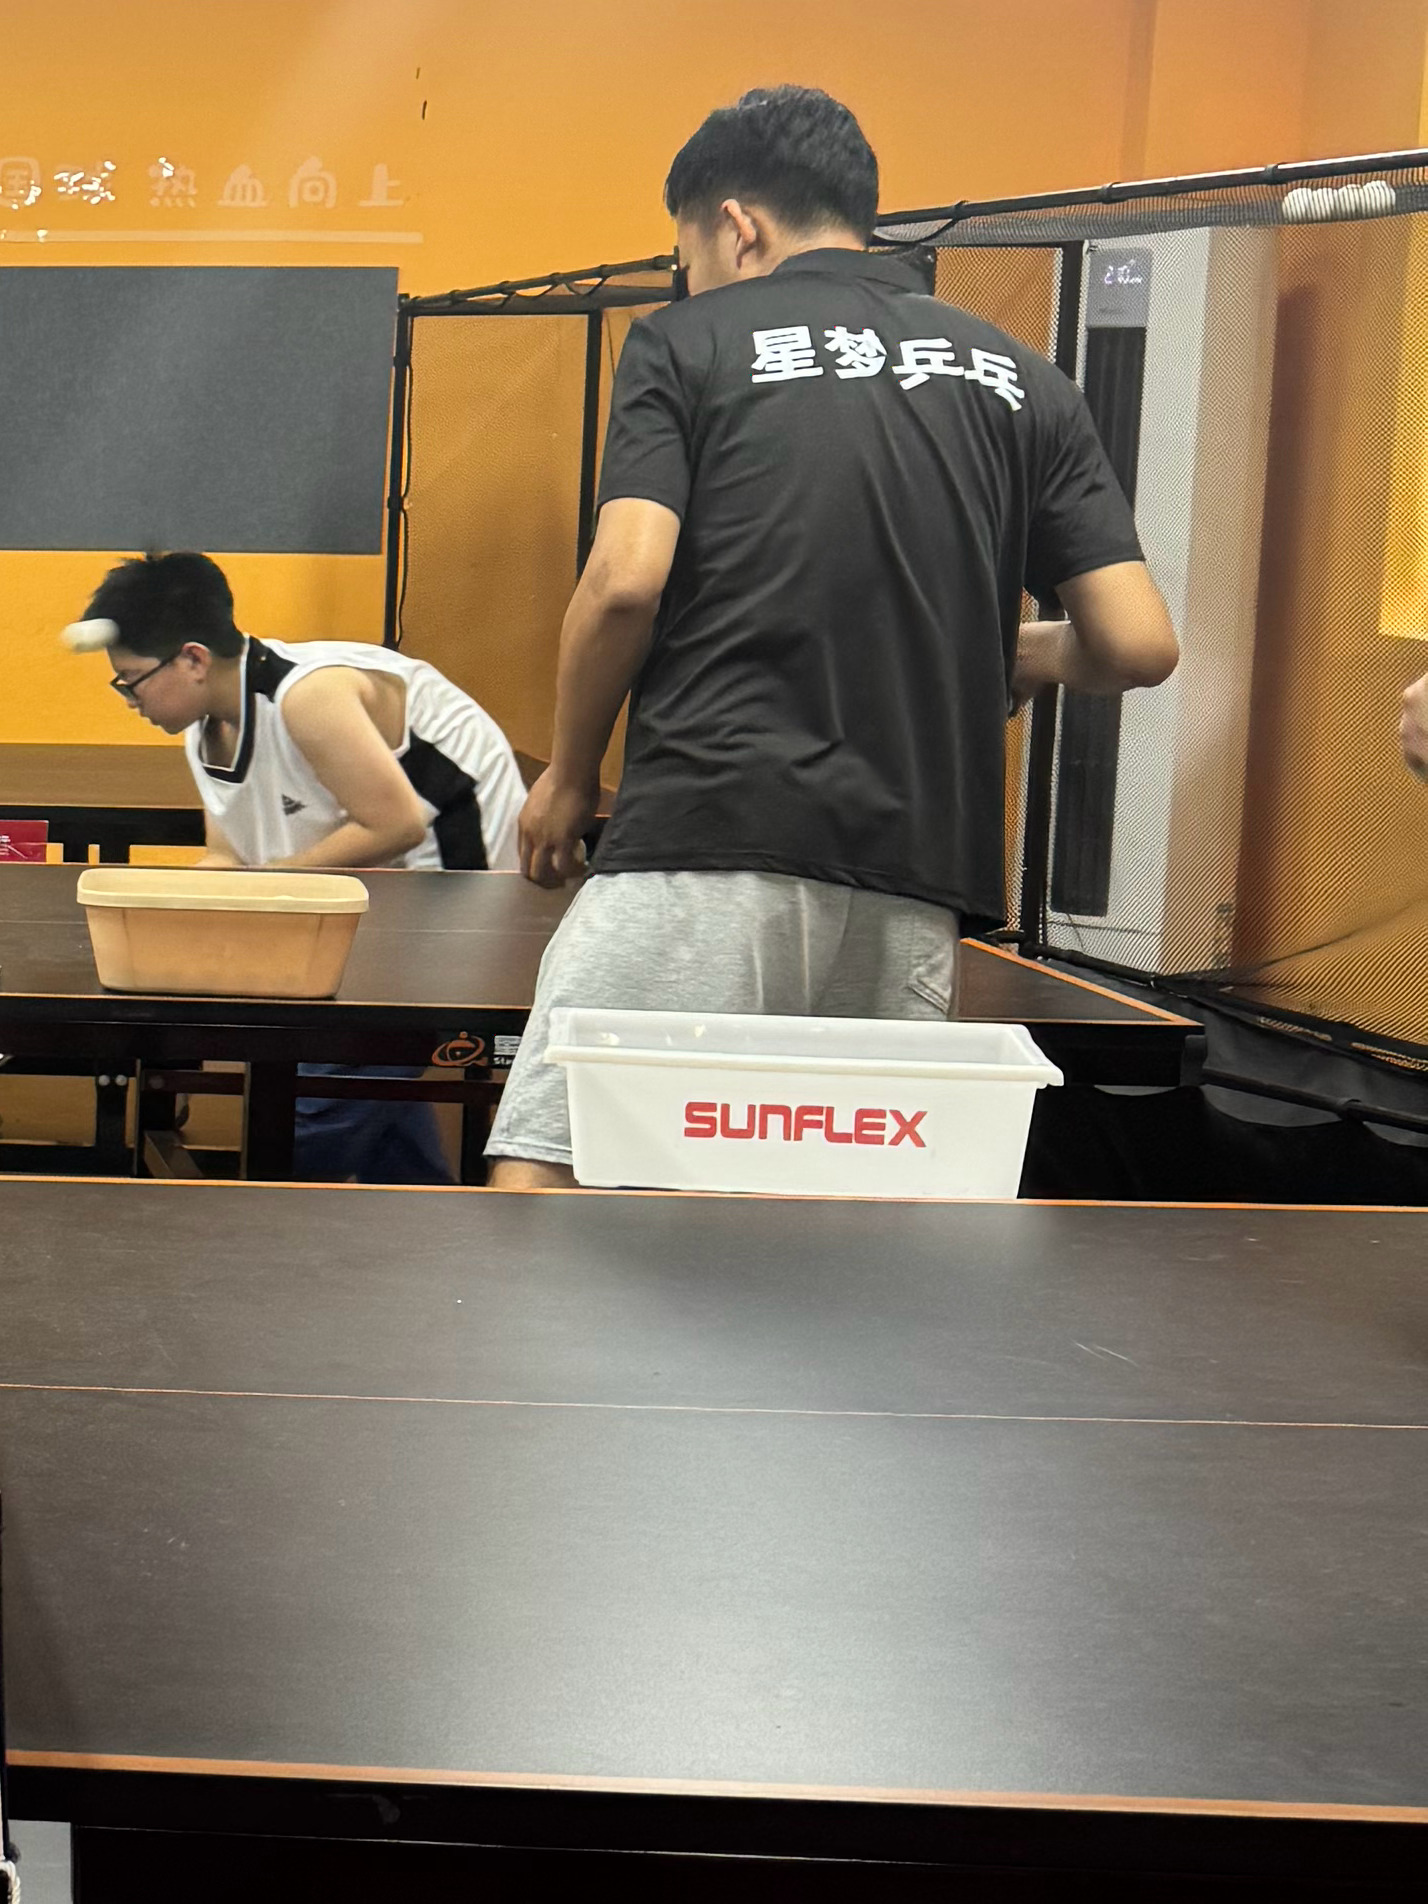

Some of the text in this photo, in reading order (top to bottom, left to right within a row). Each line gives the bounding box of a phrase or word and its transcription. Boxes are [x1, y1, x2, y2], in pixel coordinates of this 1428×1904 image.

[149, 155, 409, 209] 热血向上
[751, 326, 1025, 411] 星梦乒乓
[684, 1101, 928, 1148] SUNFLEX
